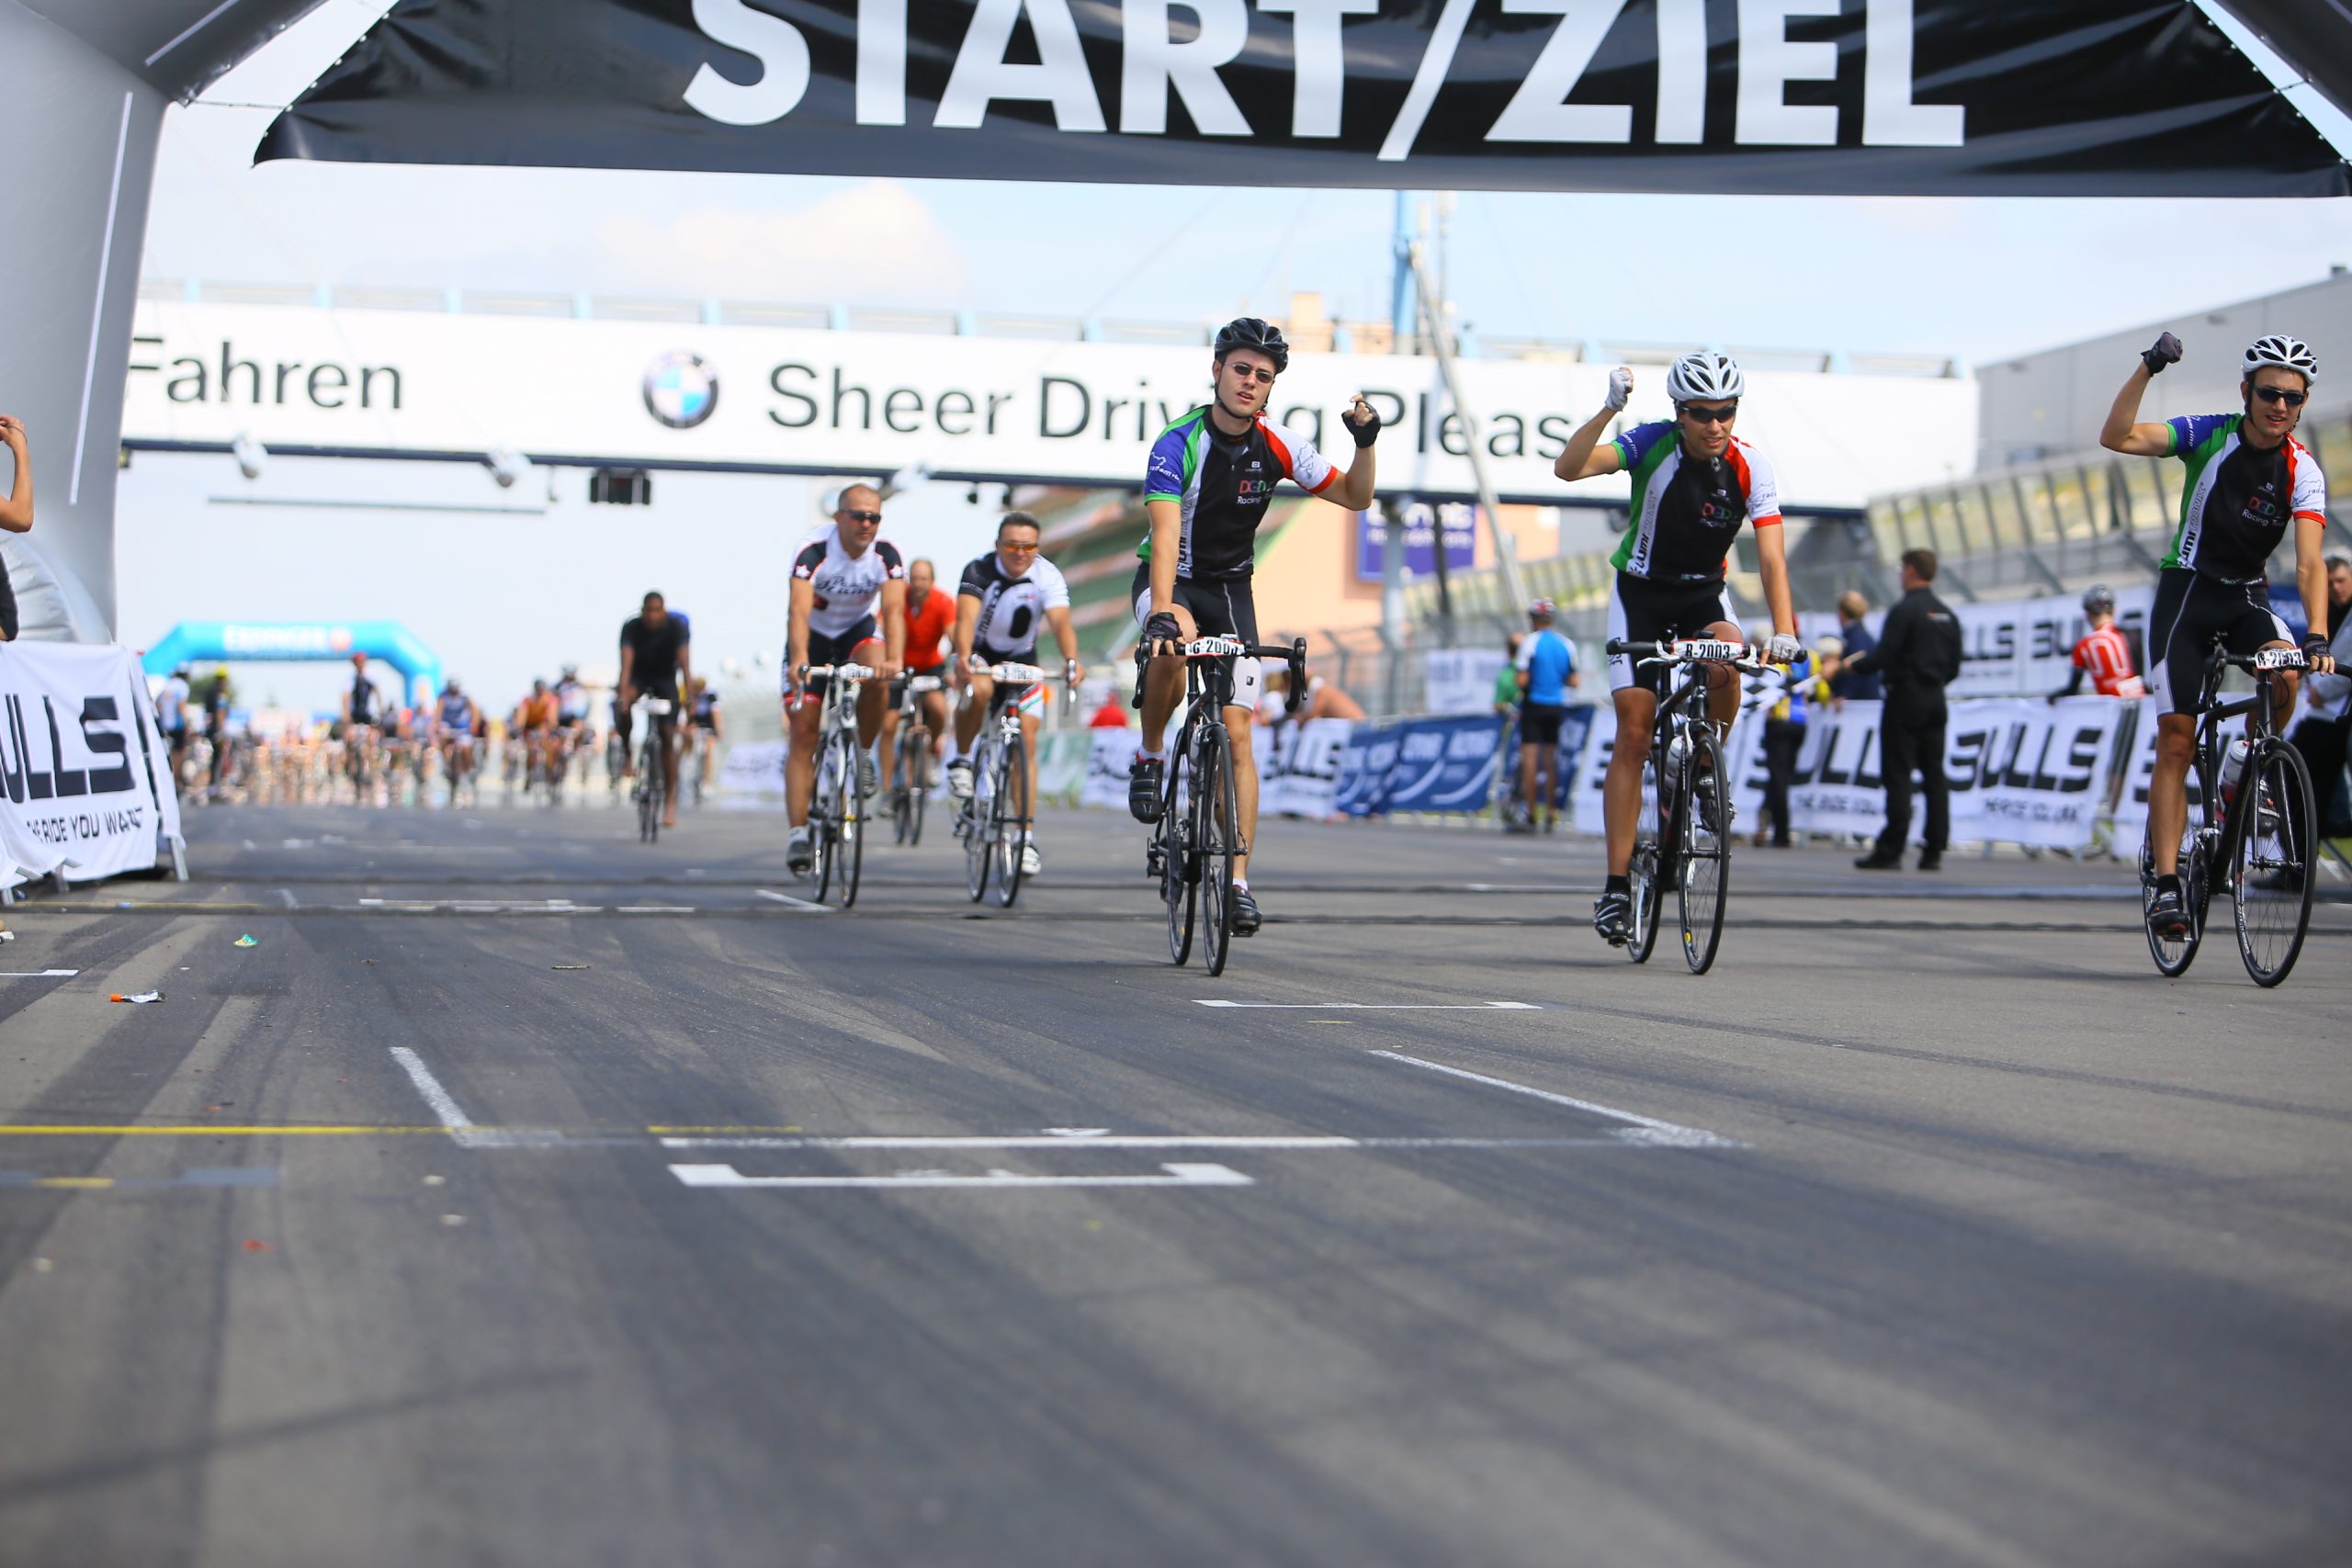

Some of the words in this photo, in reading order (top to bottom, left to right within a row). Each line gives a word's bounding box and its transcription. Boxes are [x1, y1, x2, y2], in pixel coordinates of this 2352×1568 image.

[768, 364, 1012, 434] Sheer
[2242, 508, 2269, 527] Racing
[0, 694, 137, 804] ULLS
[70, 812, 100, 840] YOU
